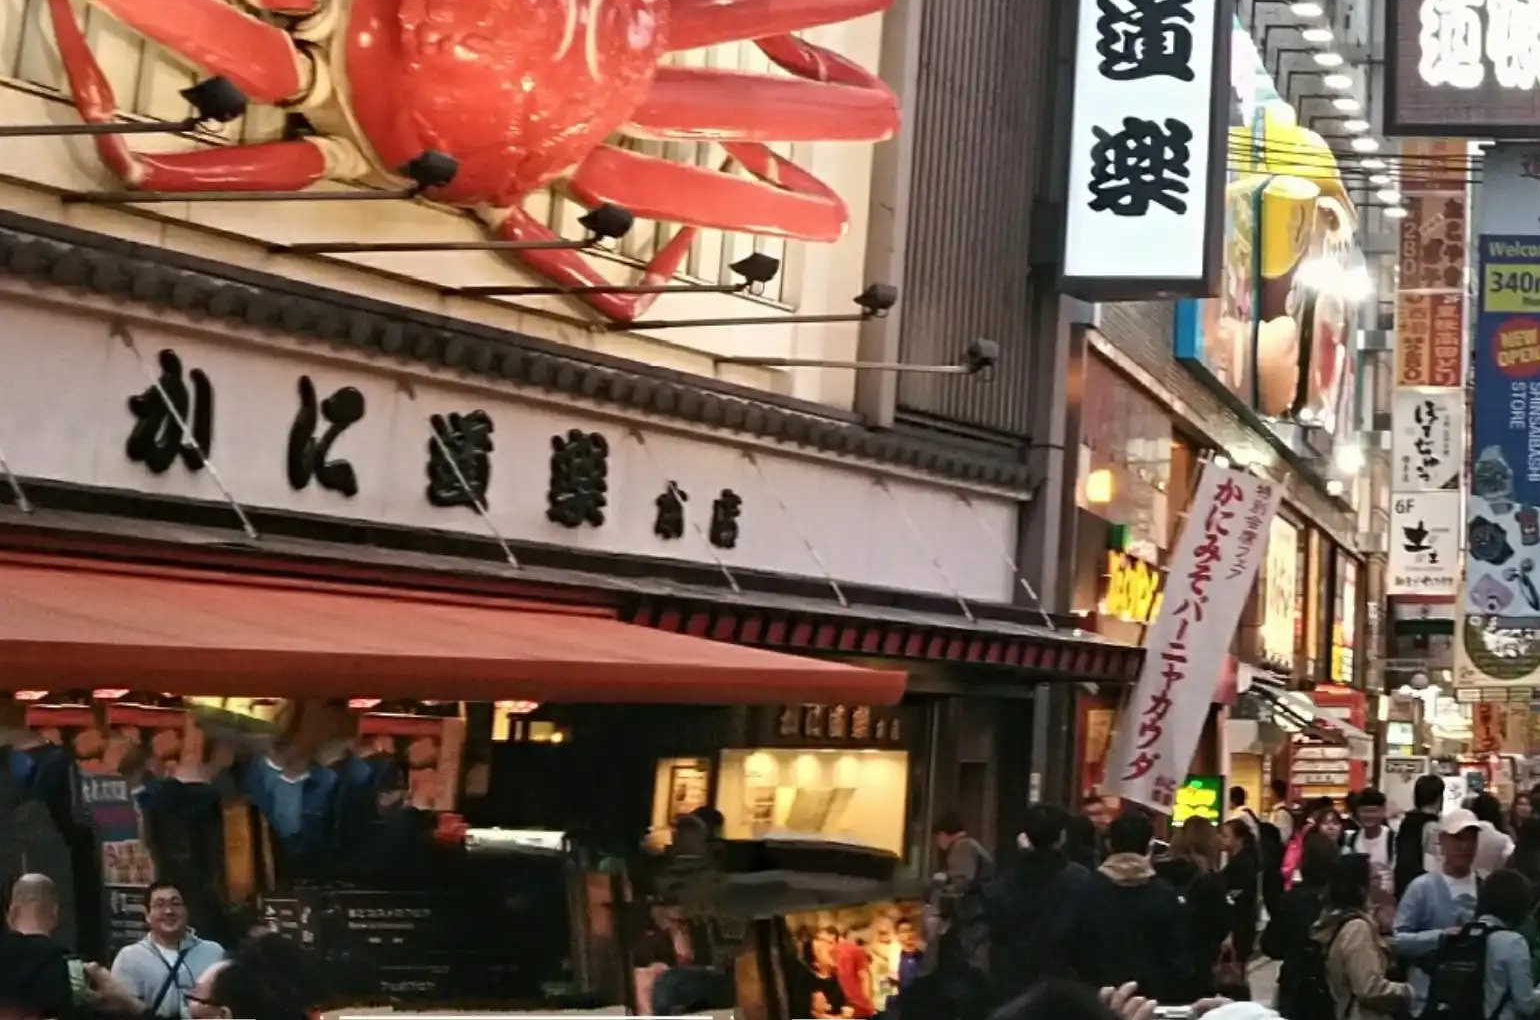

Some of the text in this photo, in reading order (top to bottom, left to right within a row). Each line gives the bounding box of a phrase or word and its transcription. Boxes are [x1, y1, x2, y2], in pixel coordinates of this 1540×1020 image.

[1500, 328, 1539, 346] NEW
[1509, 381, 1526, 430] STORE
[1395, 498, 1415, 514] 6F
[1121, 477, 1244, 782] かにみそバーニャカウダ
